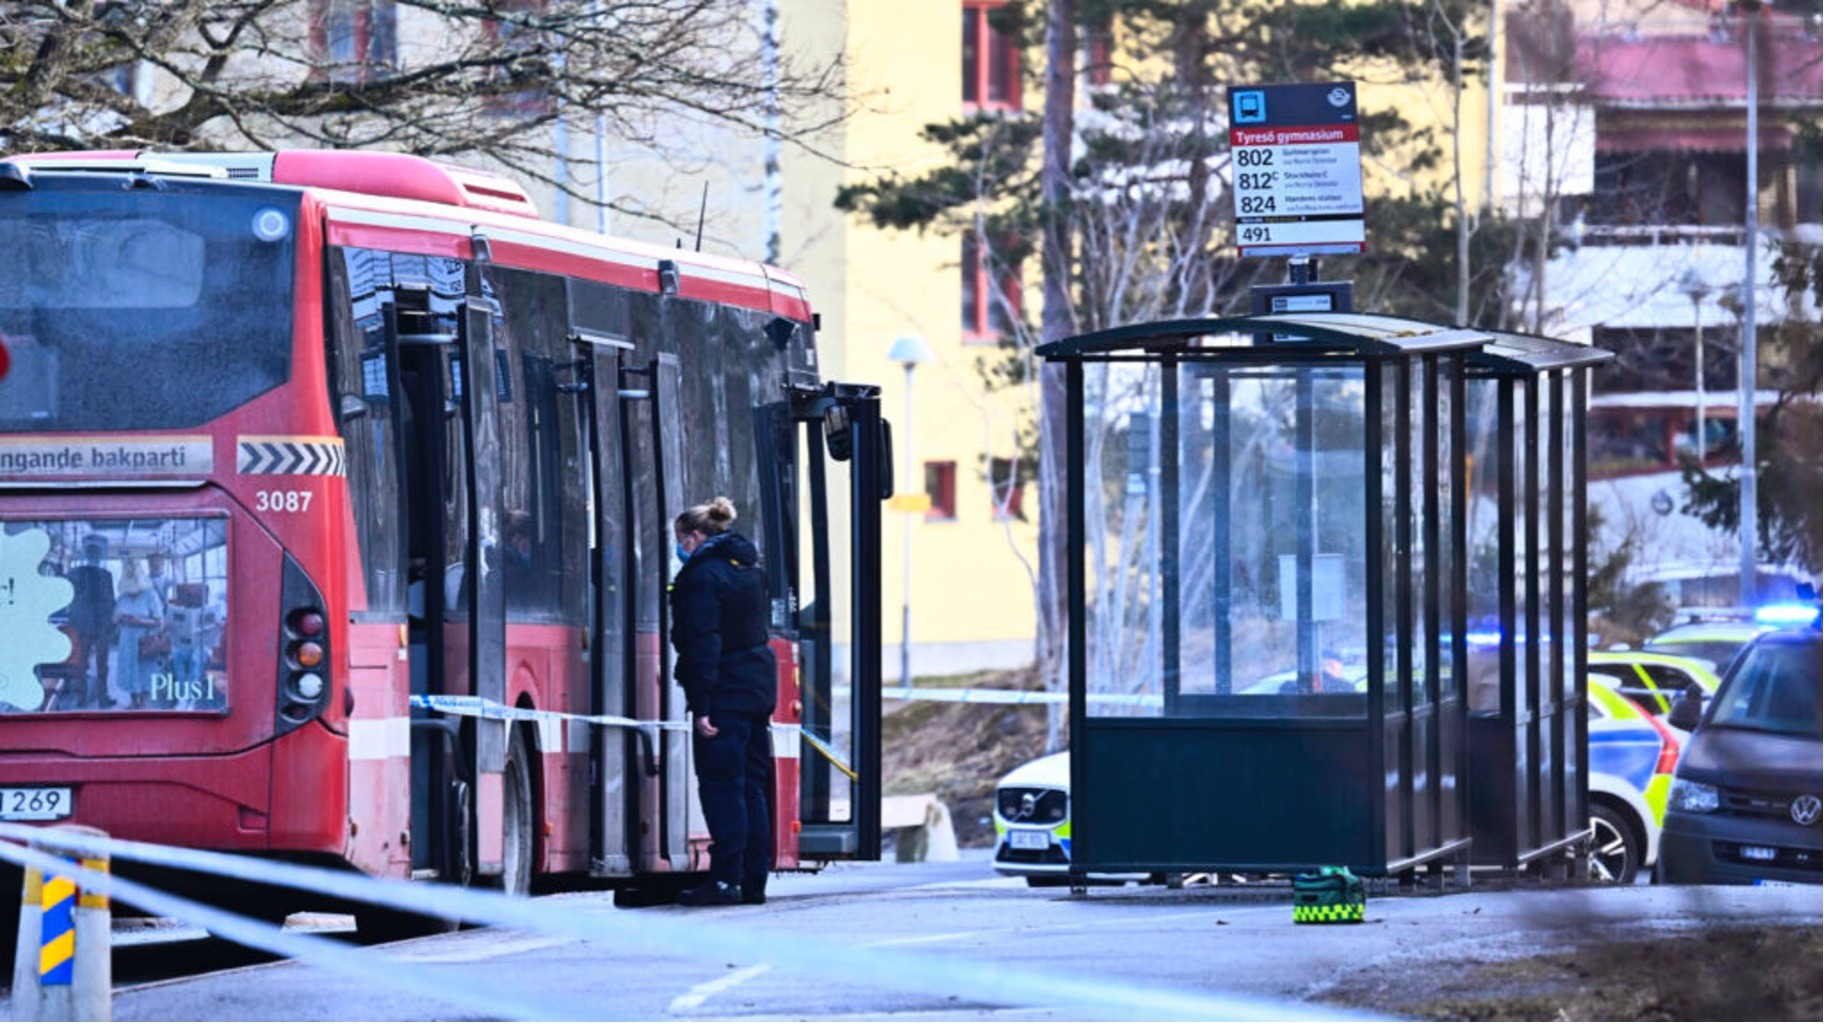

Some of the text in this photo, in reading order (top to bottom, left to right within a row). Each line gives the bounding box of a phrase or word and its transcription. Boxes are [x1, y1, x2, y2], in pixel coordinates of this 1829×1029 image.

[1236, 130, 1343, 145] Tyresö gymnasium
[1238, 149, 1273, 167] 802
[1241, 196, 1276, 213] 824
[1243, 227, 1272, 241] 491
[1, 445, 186, 471] ngande bakparti
[256, 491, 313, 512] 3087
[12, 791, 60, 811] 269
